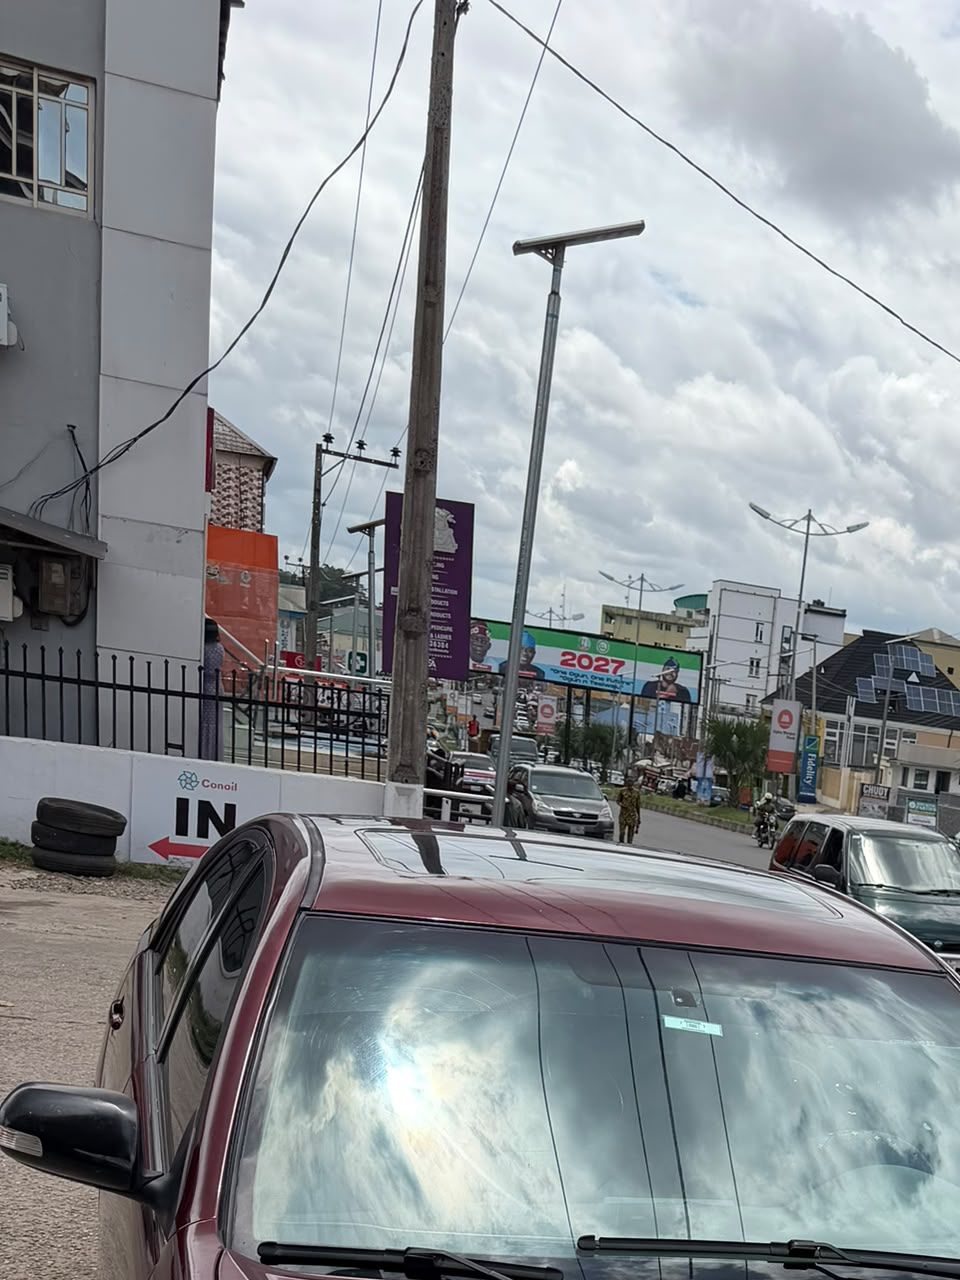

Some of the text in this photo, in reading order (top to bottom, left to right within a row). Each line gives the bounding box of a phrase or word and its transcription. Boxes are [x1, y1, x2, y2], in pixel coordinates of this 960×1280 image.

[559, 651, 626, 676] 2027
[804, 753, 816, 786] Fidelity
[201, 779, 238, 792] Conoil
[175, 797, 237, 839] IN
